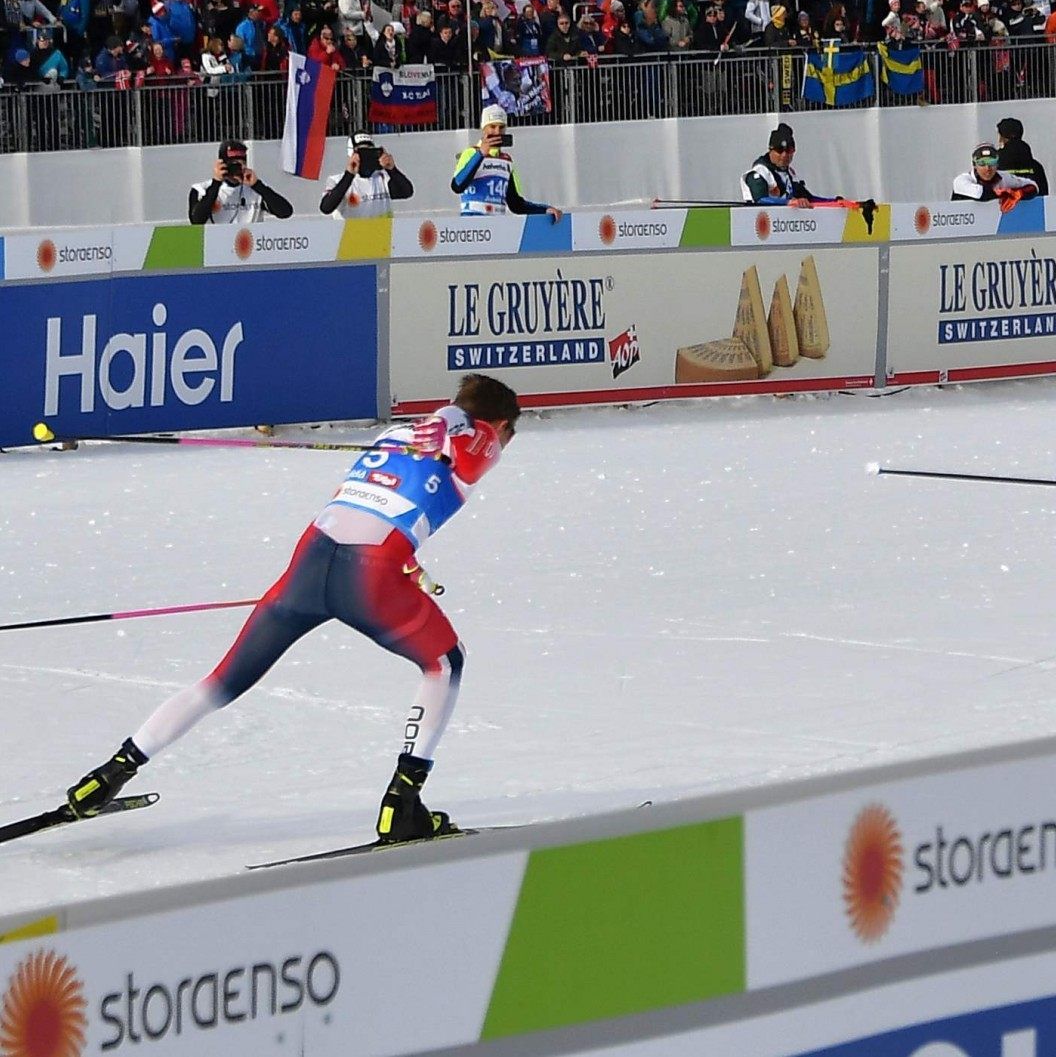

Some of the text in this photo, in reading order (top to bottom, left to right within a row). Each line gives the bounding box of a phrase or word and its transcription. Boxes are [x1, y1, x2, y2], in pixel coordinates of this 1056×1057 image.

[772, 217, 817, 233] storaenso
[932, 210, 975, 227] storaenso
[440, 227, 492, 244] storaenso
[618, 220, 668, 238] storaenso
[256, 235, 308, 252] storaenso
[60, 245, 112, 263] storaenso
[939, 263, 967, 314] LE
[447, 268, 606, 337] LE GRUYÈRE
[44, 302, 244, 417] Haier
[454, 341, 599, 367] SWITZERLAND
[424, 474, 442, 494] 5
[343, 487, 389, 506] storaenso
[100, 950, 341, 1052] storaenso
